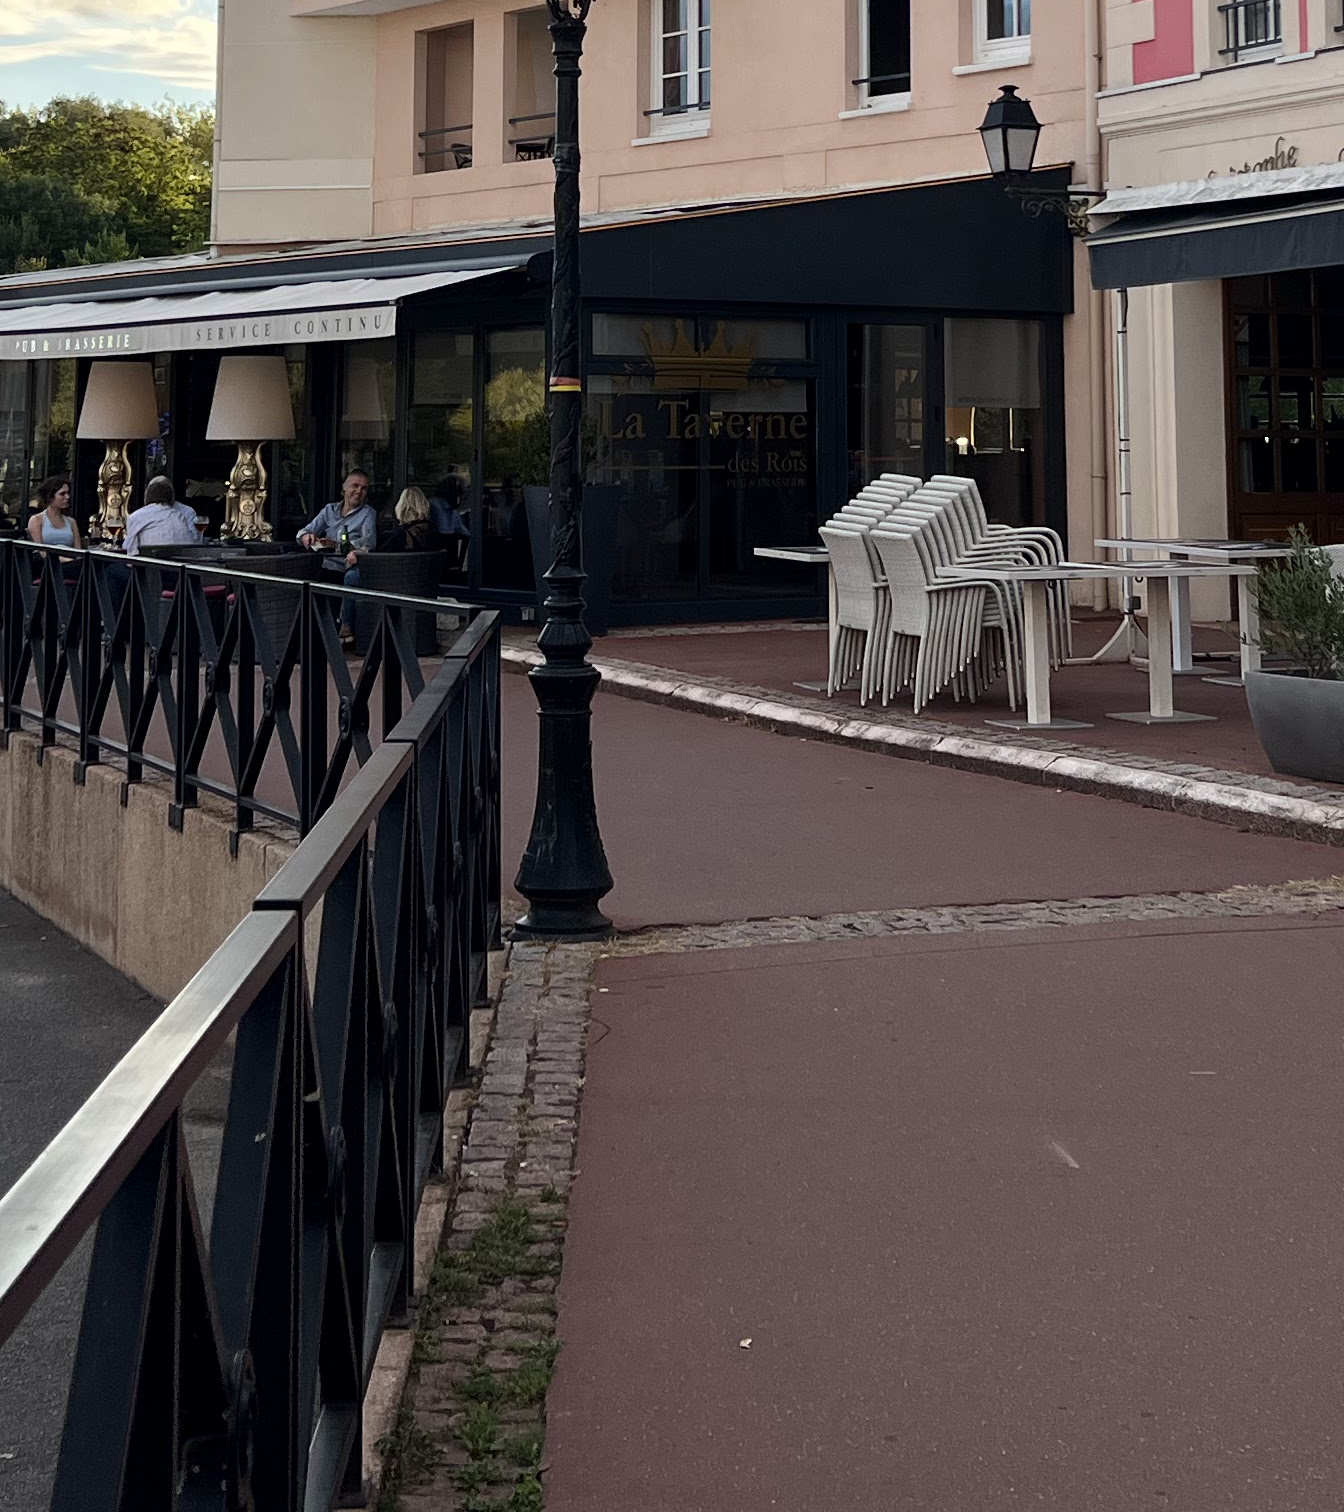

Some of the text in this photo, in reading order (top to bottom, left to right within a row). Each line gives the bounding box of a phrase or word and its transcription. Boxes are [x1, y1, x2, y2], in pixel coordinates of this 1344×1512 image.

[15, 340, 37, 354] PUB
[57, 334, 131, 352] BRASSERIE
[195, 322, 271, 343] SERVICE
[293, 314, 383, 336] CONTINU
[598, 399, 808, 439] La Taverne
[726, 451, 760, 473] des
